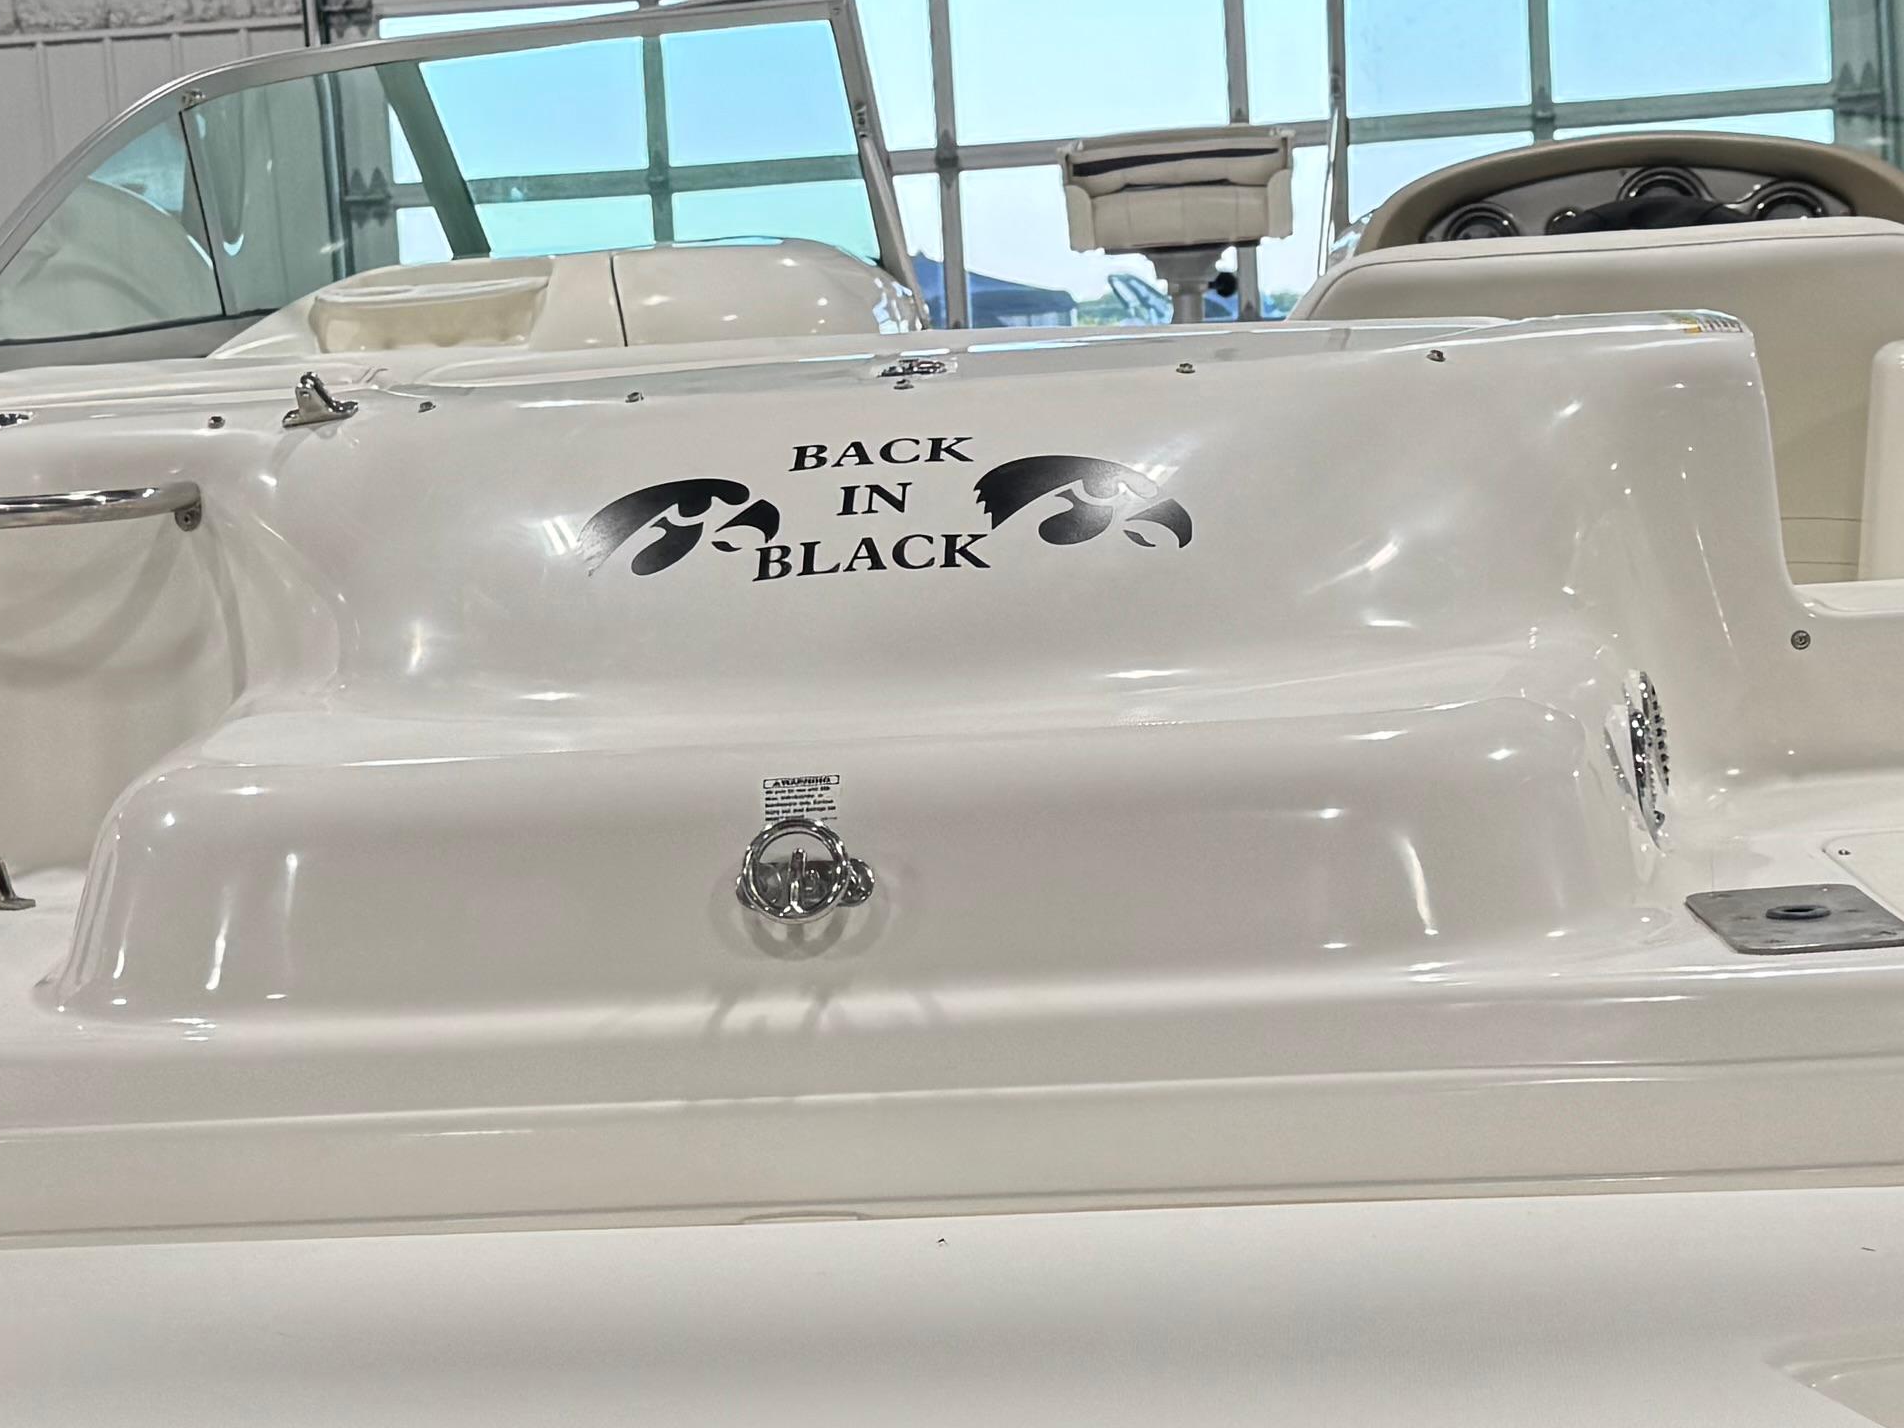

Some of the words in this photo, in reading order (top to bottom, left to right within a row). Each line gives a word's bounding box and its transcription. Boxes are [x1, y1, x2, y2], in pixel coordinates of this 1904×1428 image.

[788, 436, 974, 471] BACK
[837, 481, 912, 516] IN
[752, 532, 992, 581] BLACK
